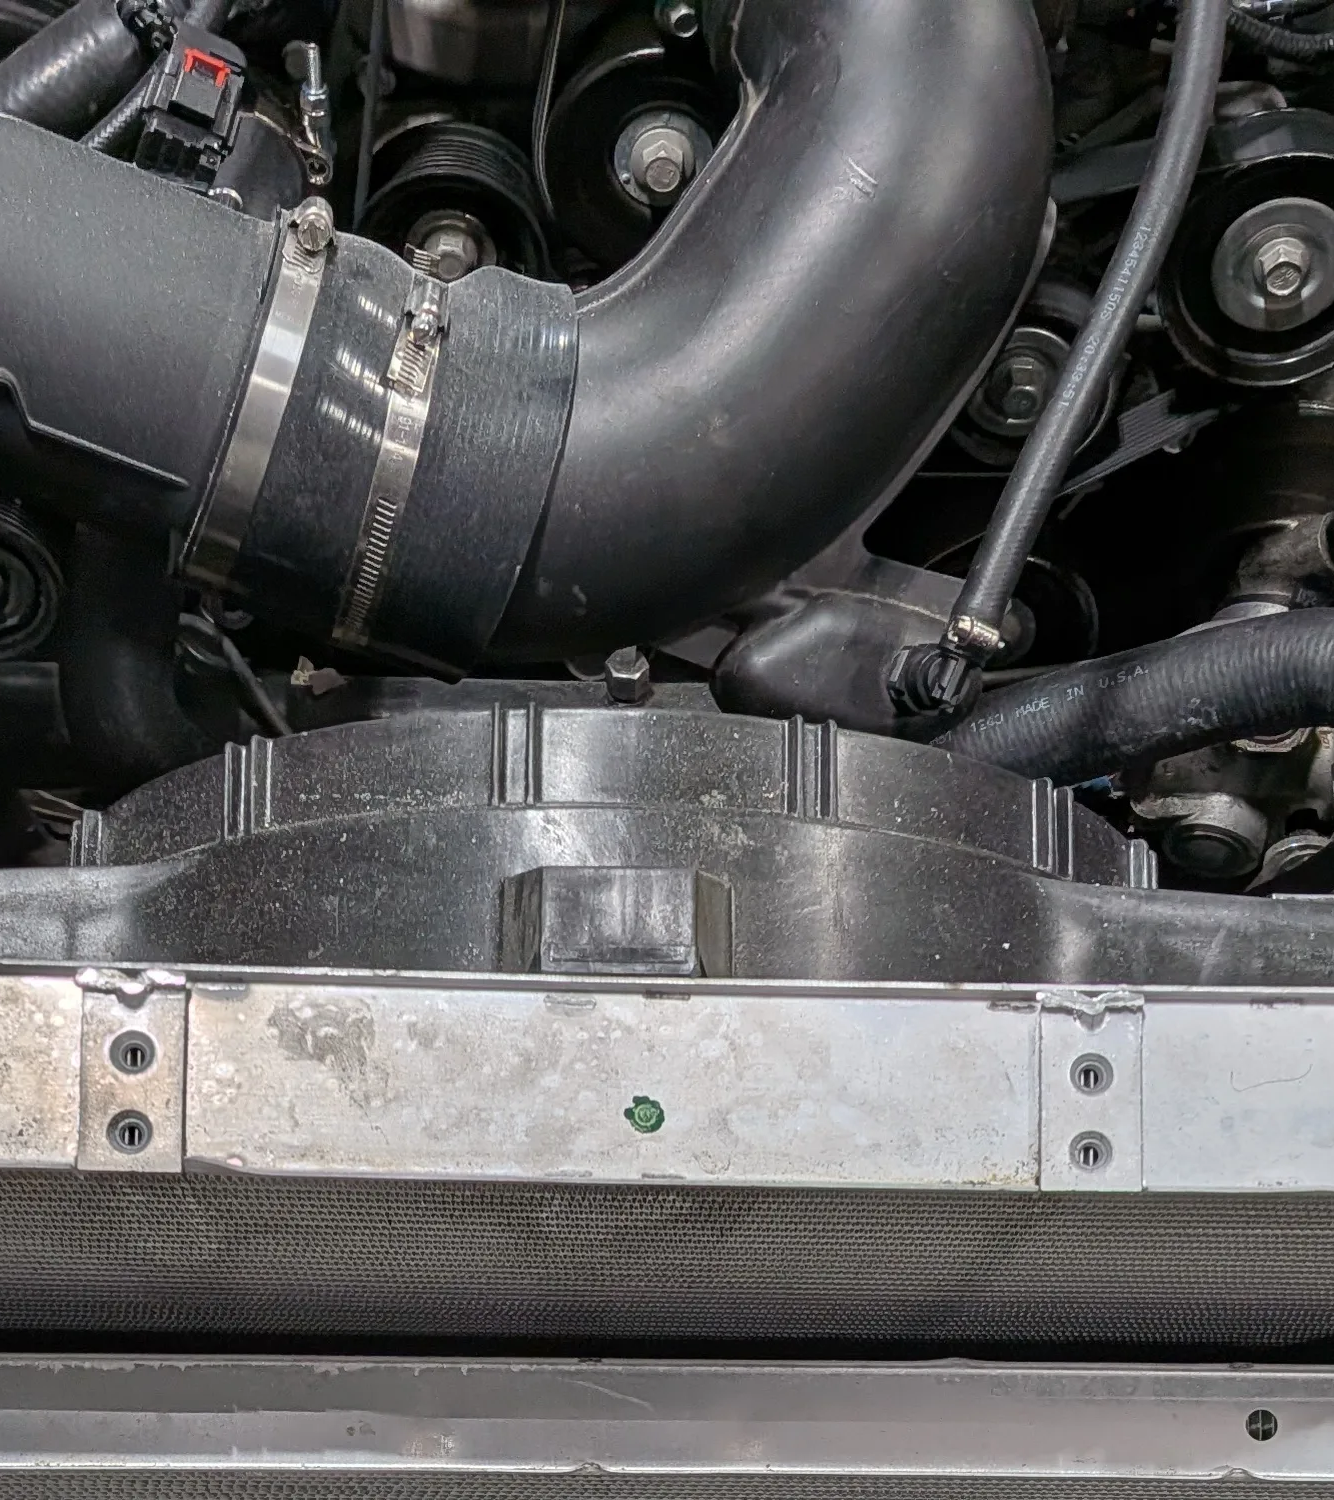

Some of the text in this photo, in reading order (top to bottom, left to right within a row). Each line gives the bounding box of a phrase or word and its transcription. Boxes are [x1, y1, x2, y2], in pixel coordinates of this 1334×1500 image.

[1015, 697, 1050, 718] MADE
[1066, 684, 1084, 701] IN
[1098, 664, 1149, 689] U.S.A.
